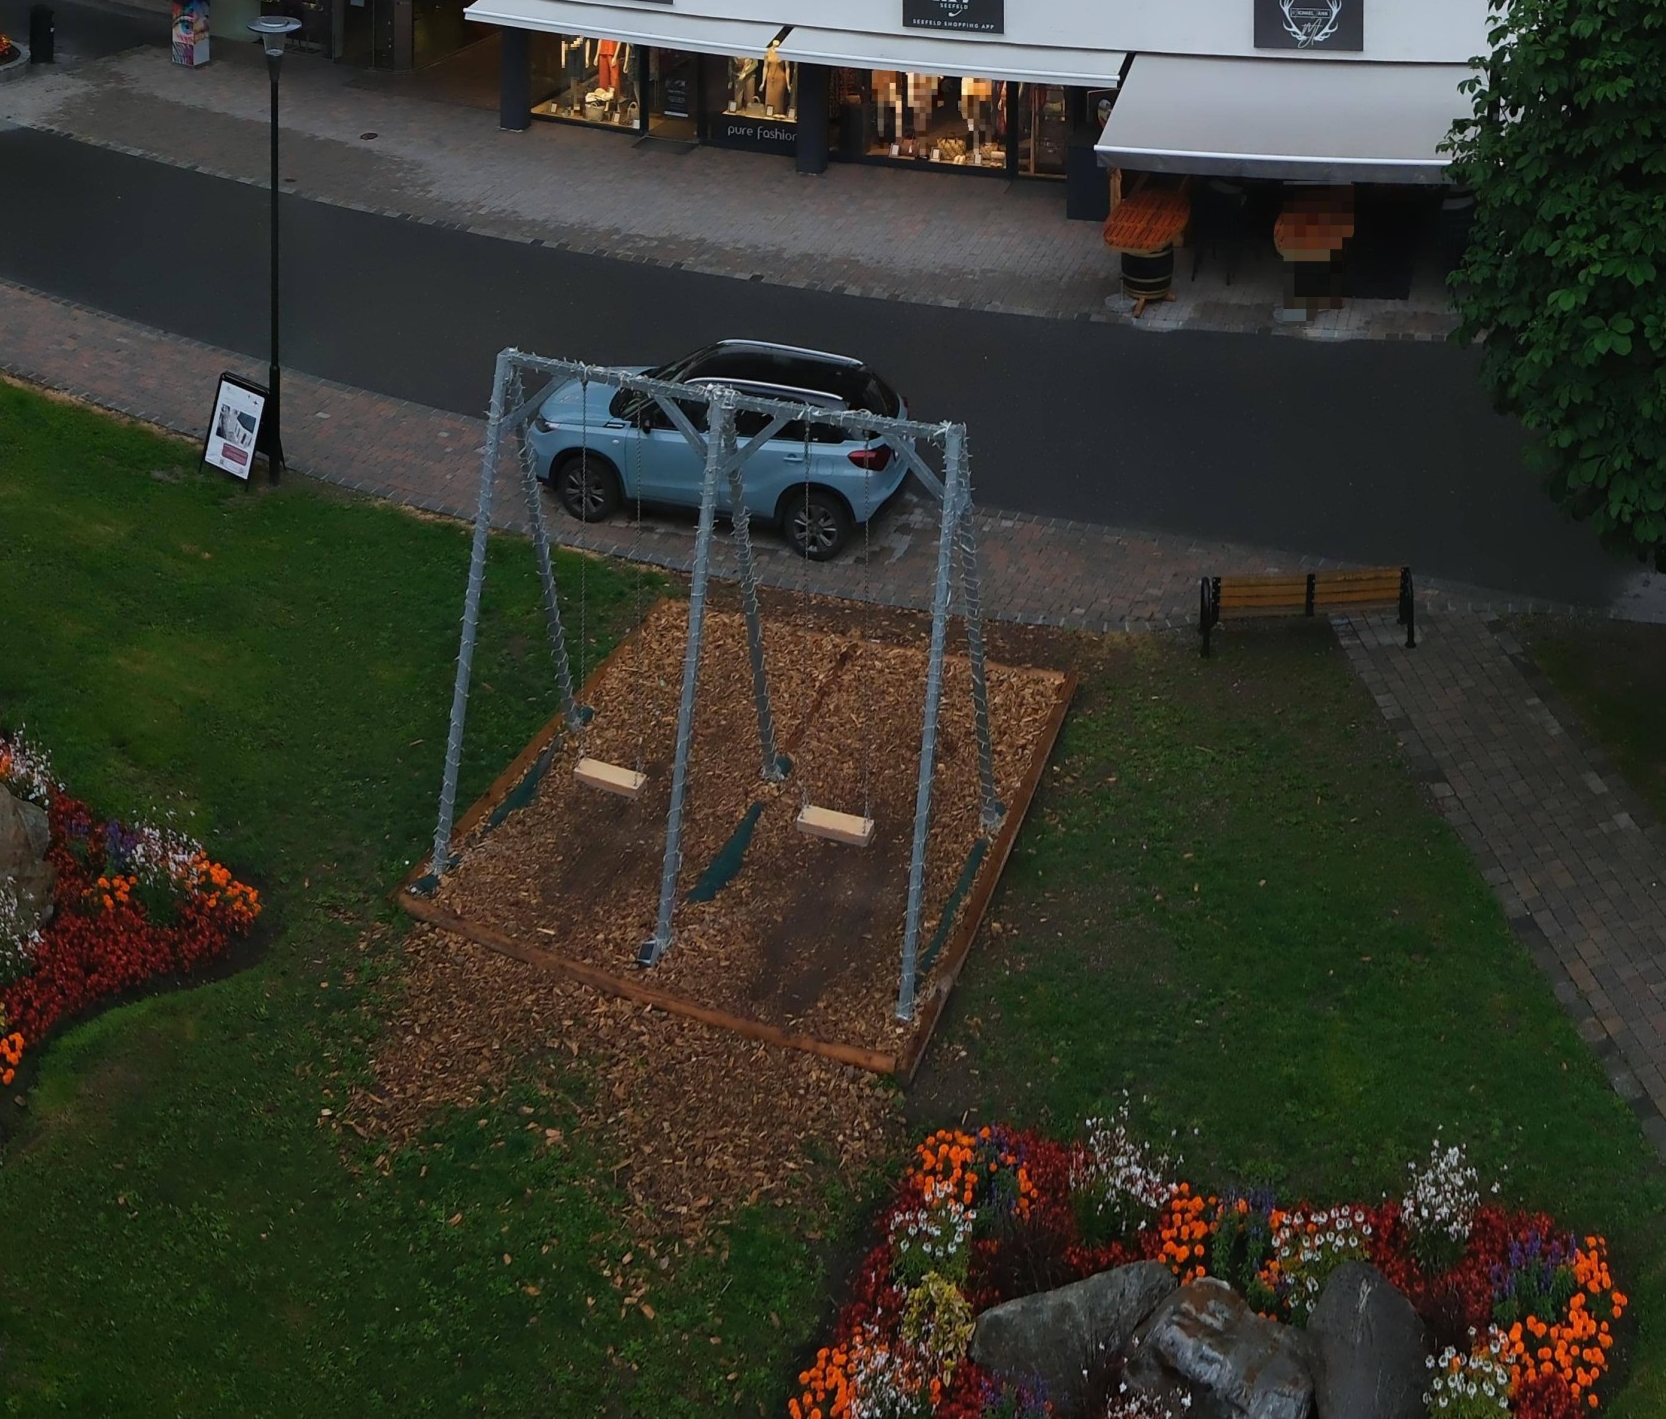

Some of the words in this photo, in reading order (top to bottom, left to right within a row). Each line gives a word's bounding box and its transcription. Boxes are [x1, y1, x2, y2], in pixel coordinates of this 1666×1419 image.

[939, 2, 969, 10] SEEFELD
[944, 21, 979, 29] SHOPPING
[727, 125, 754, 136] pure
